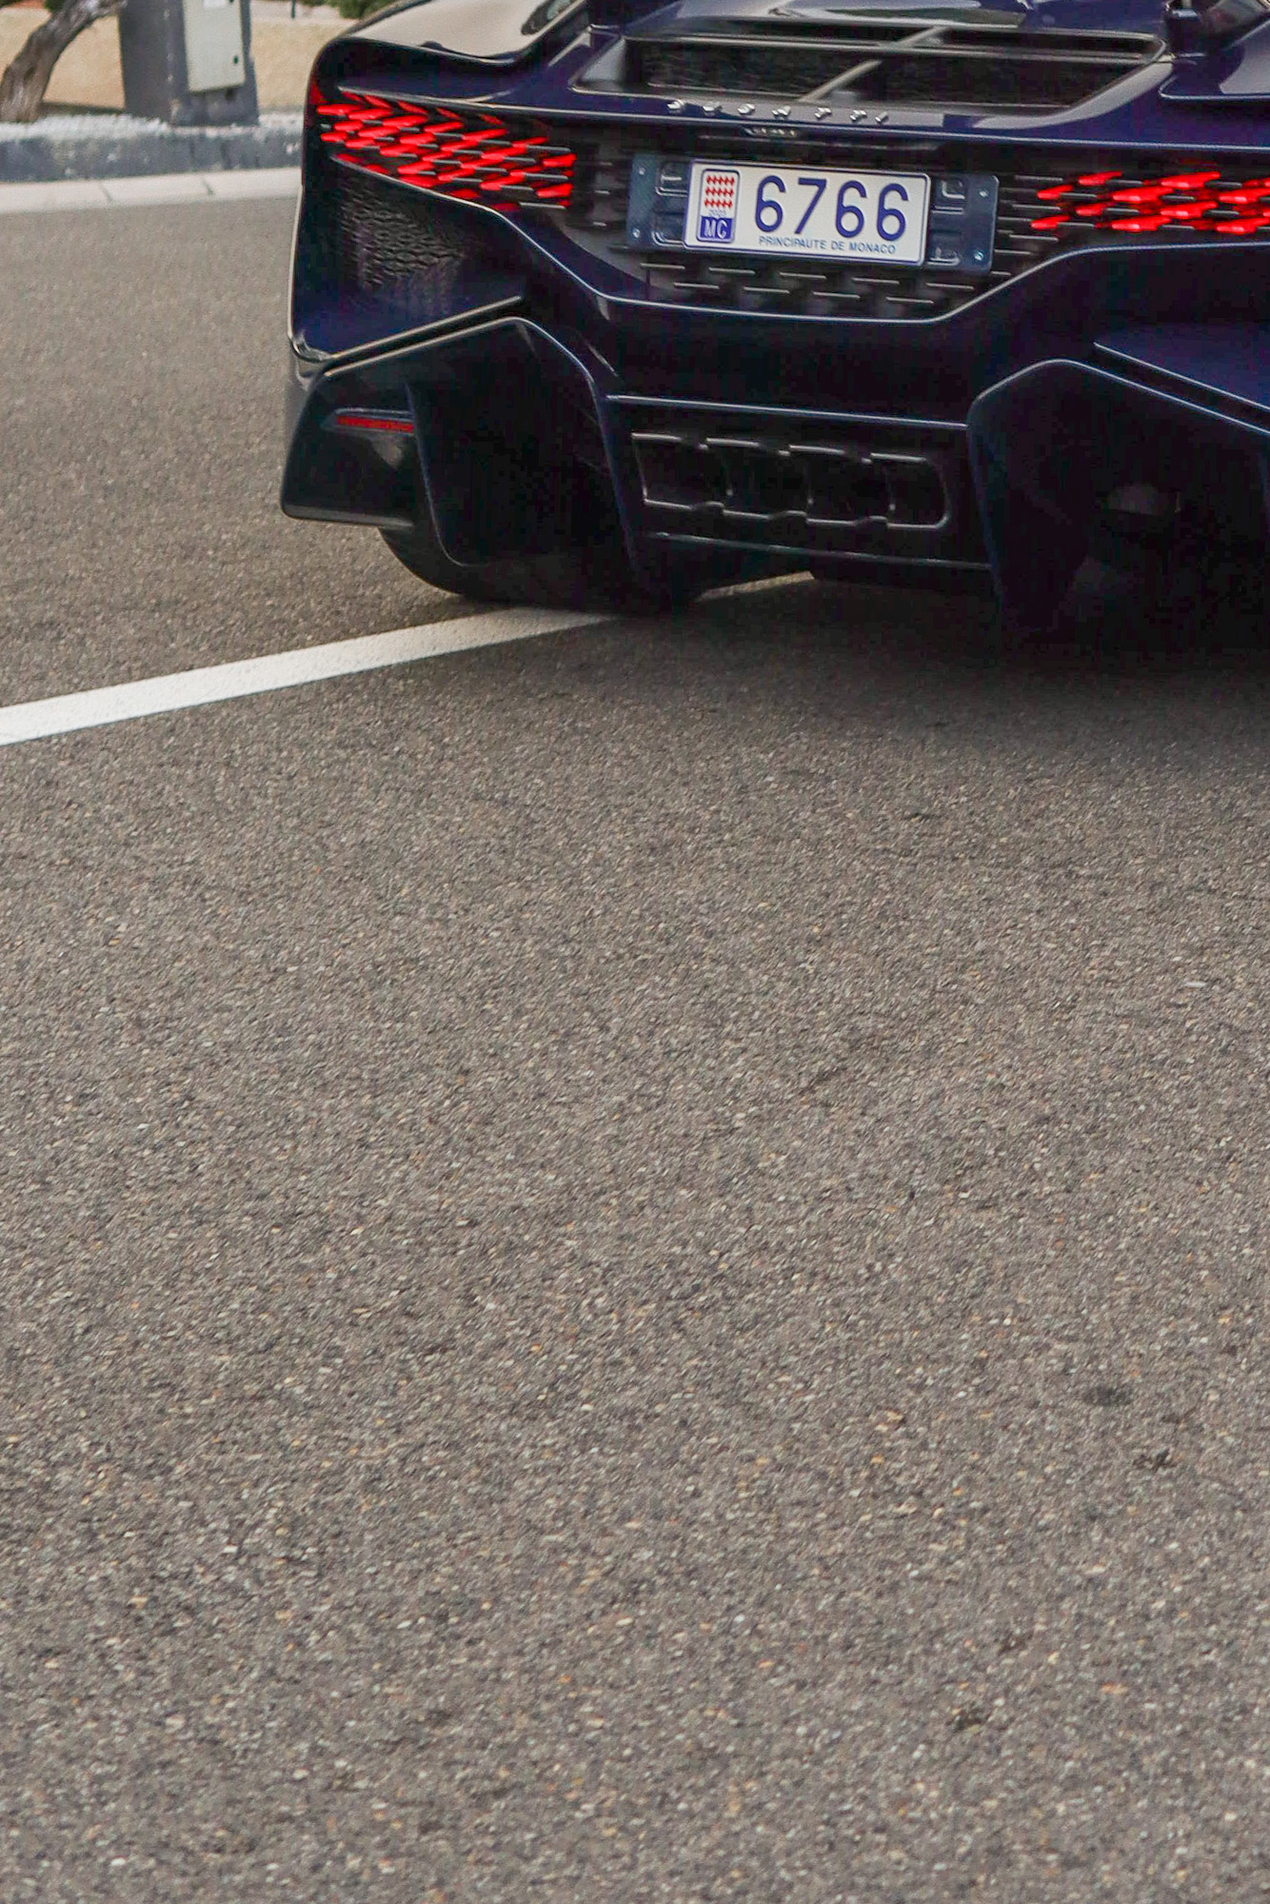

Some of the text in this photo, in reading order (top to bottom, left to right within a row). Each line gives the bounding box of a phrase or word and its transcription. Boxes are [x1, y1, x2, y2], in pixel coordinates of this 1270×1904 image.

[755, 174, 909, 242] 6766
[703, 218, 728, 239] MC
[831, 240, 844, 252] DE
[849, 242, 896, 255] MONACO
